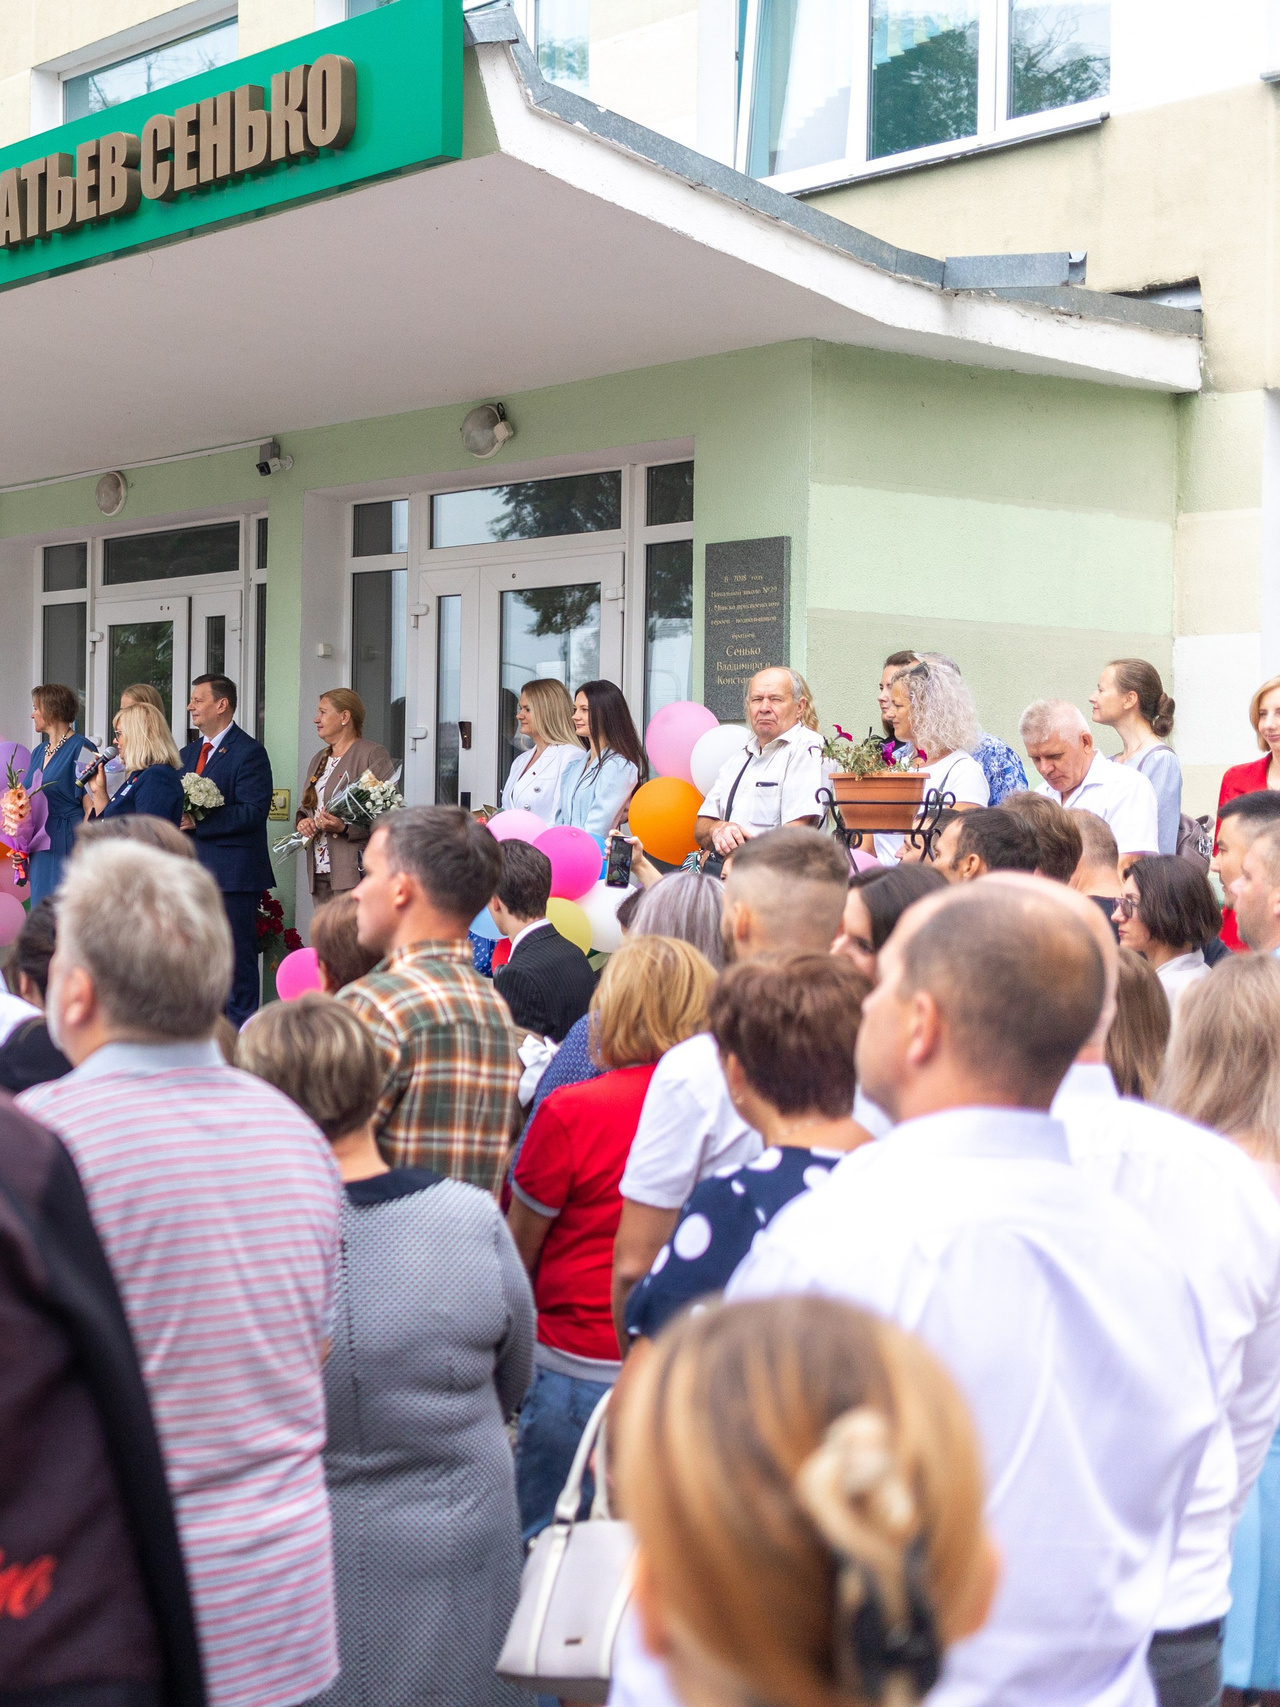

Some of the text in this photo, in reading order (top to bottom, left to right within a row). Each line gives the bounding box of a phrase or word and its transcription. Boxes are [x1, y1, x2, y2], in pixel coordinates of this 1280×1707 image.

[140, 53, 357, 202] СЕНЬКО
[725, 645, 761, 657] Сенько
[716, 661, 763, 672] Владимира
[716, 674, 749, 685] Конста
